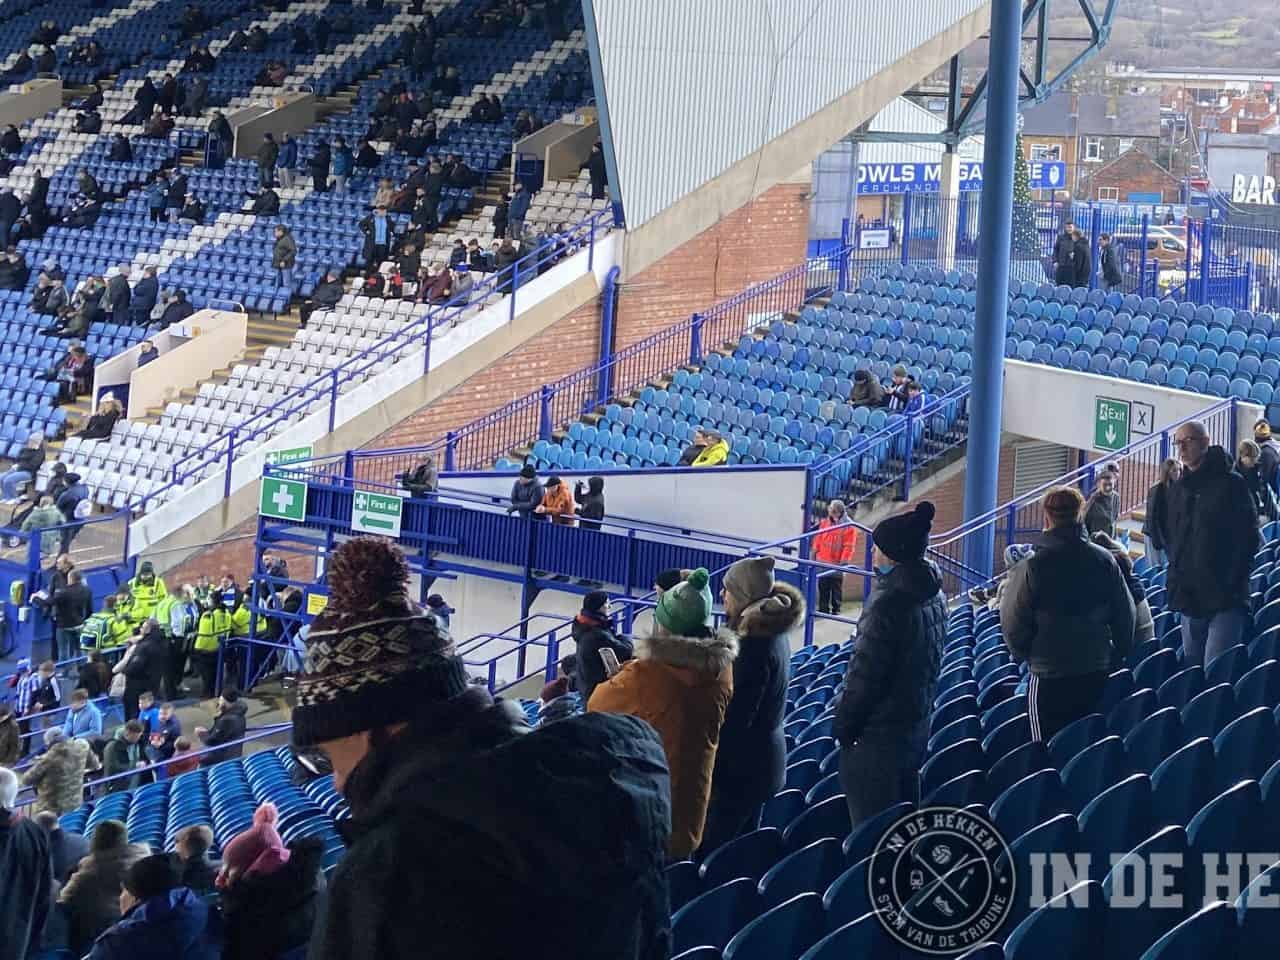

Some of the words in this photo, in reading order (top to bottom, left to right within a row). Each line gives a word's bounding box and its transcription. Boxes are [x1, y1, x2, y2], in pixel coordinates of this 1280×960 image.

[1232, 173, 1276, 205] BAR
[1109, 407, 1125, 421] Exit
[1138, 410, 1147, 427] X
[371, 498, 386, 510] First
[387, 501, 399, 511] aid
